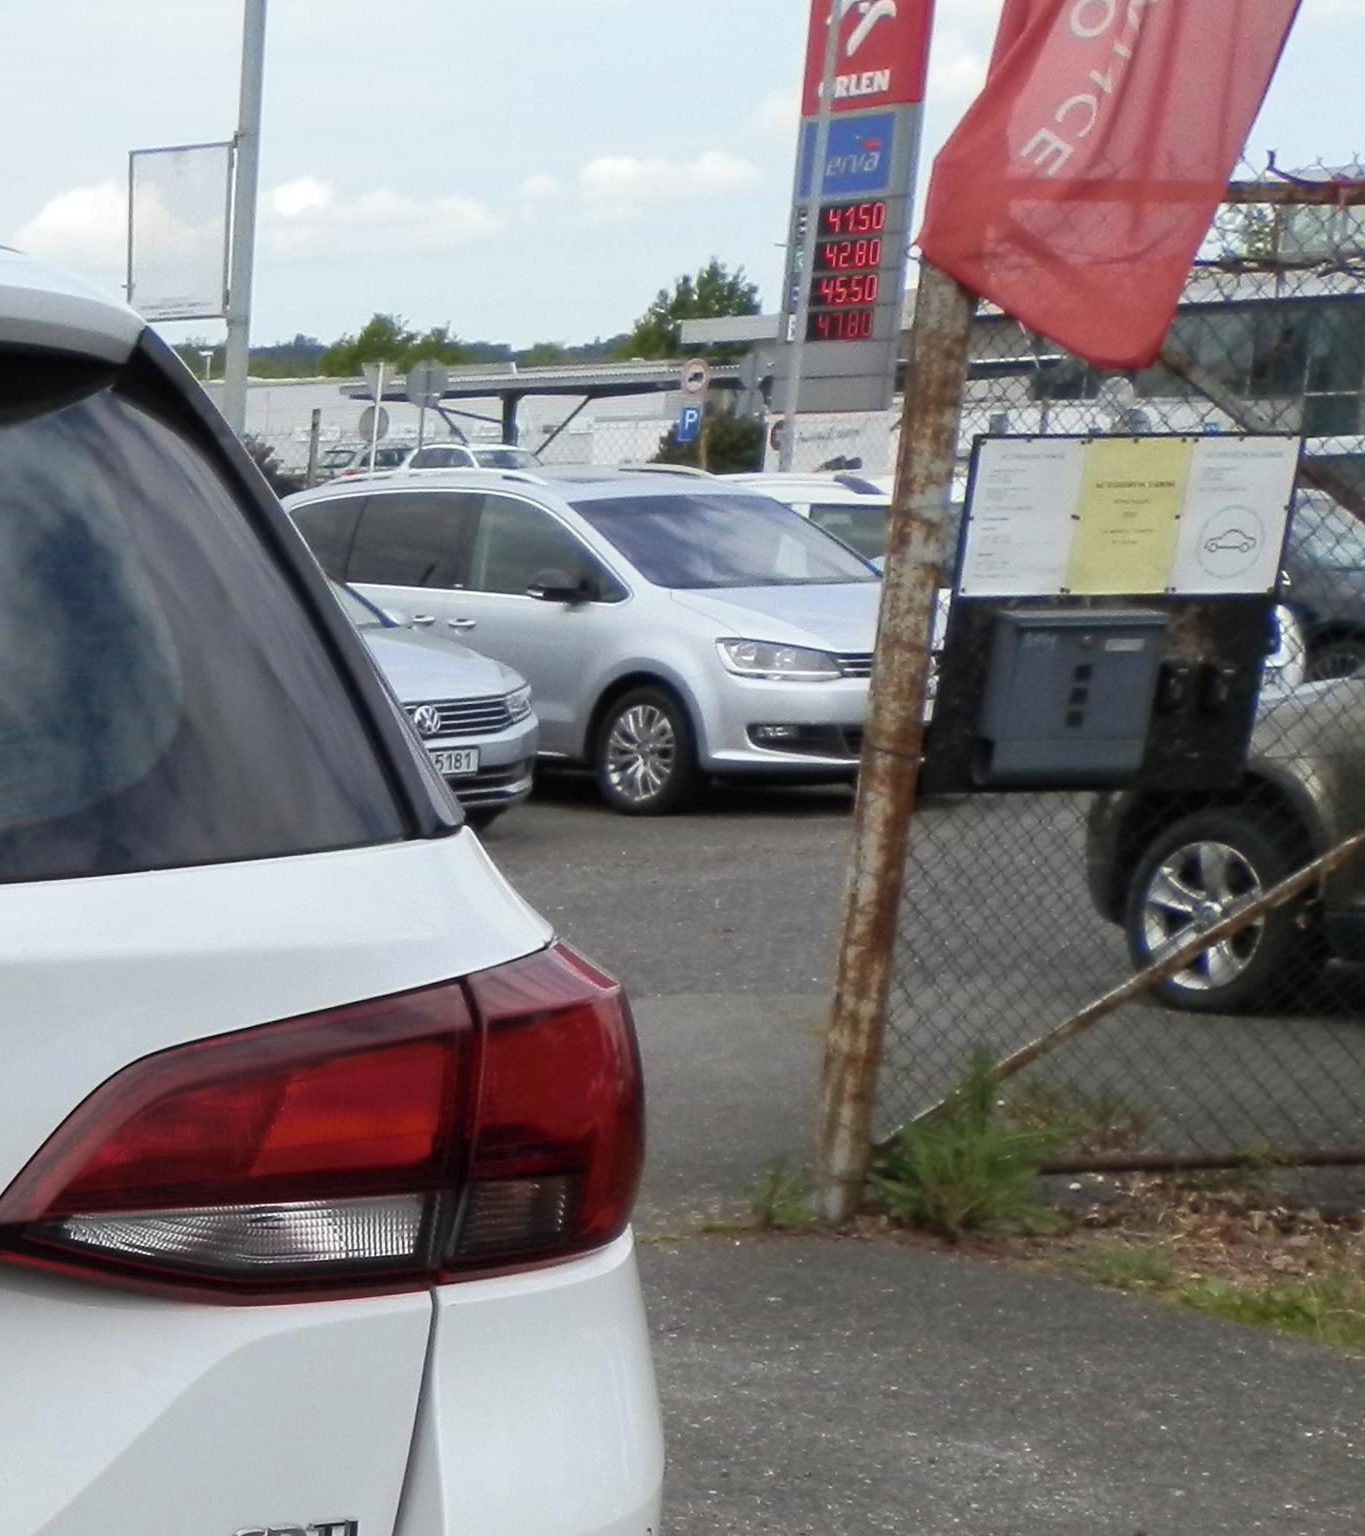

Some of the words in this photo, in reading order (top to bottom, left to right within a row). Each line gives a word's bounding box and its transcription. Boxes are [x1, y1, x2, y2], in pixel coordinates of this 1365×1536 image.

[818, 69, 891, 98] RLEN
[826, 152, 881, 177] erva
[684, 409, 699, 430] P
[435, 751, 472, 773] 5181
